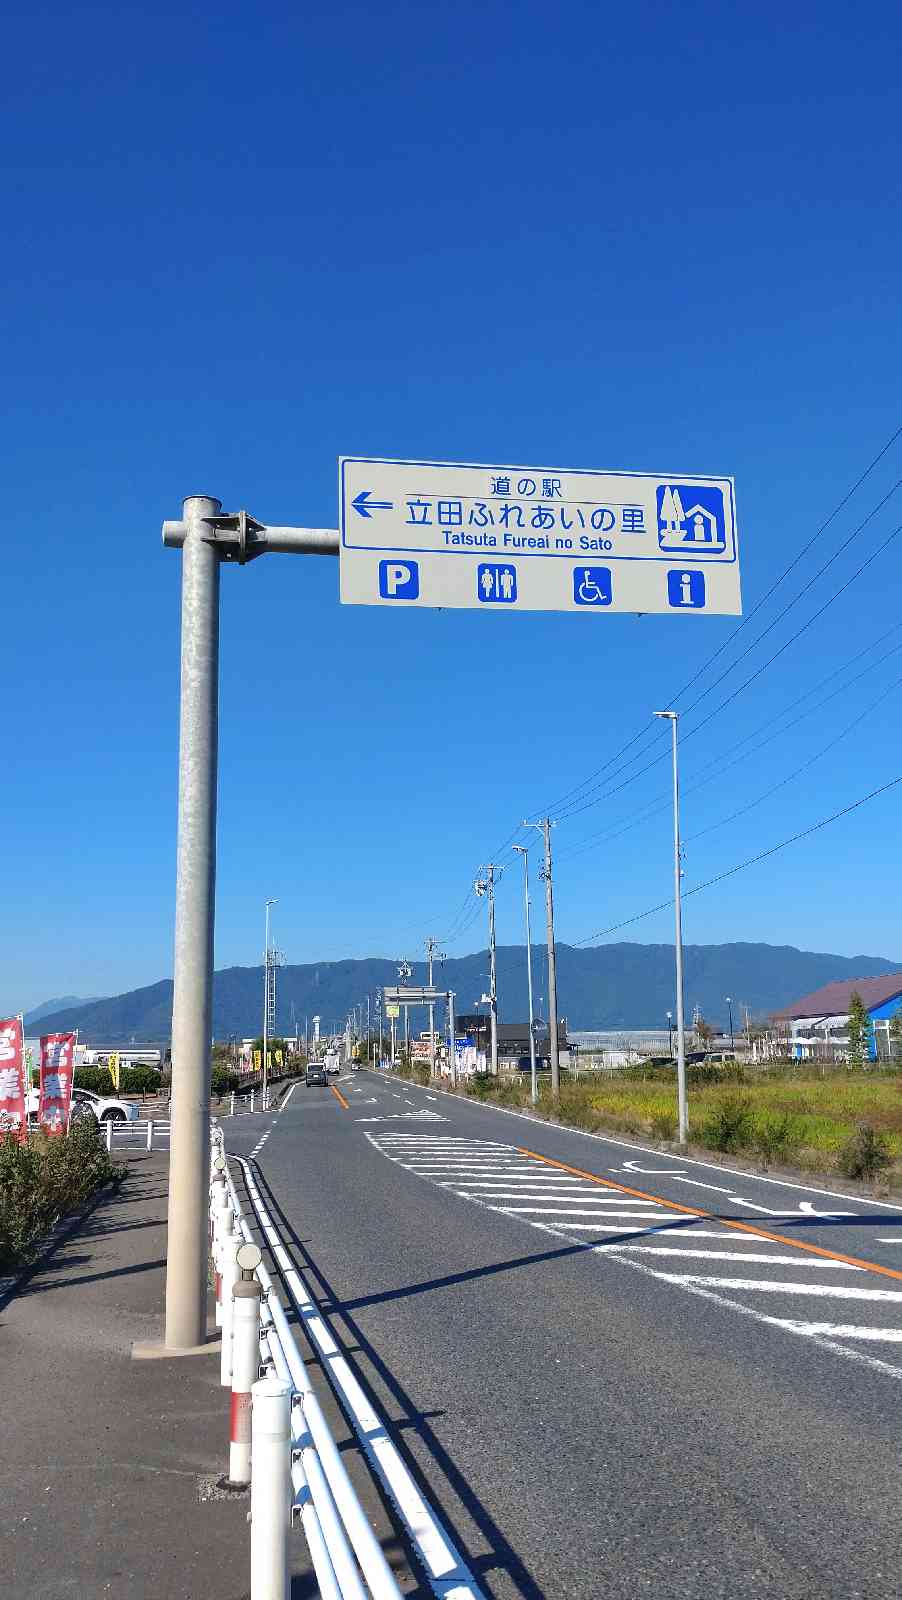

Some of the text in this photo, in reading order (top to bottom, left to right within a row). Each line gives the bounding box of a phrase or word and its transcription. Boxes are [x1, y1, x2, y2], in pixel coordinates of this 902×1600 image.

[491, 477, 562, 498] 道の駅
[406, 500, 646, 533] 立田ふれあいの里
[443, 530, 613, 552] Tatsuta Fureai no Sato
[387, 564, 411, 595] P
